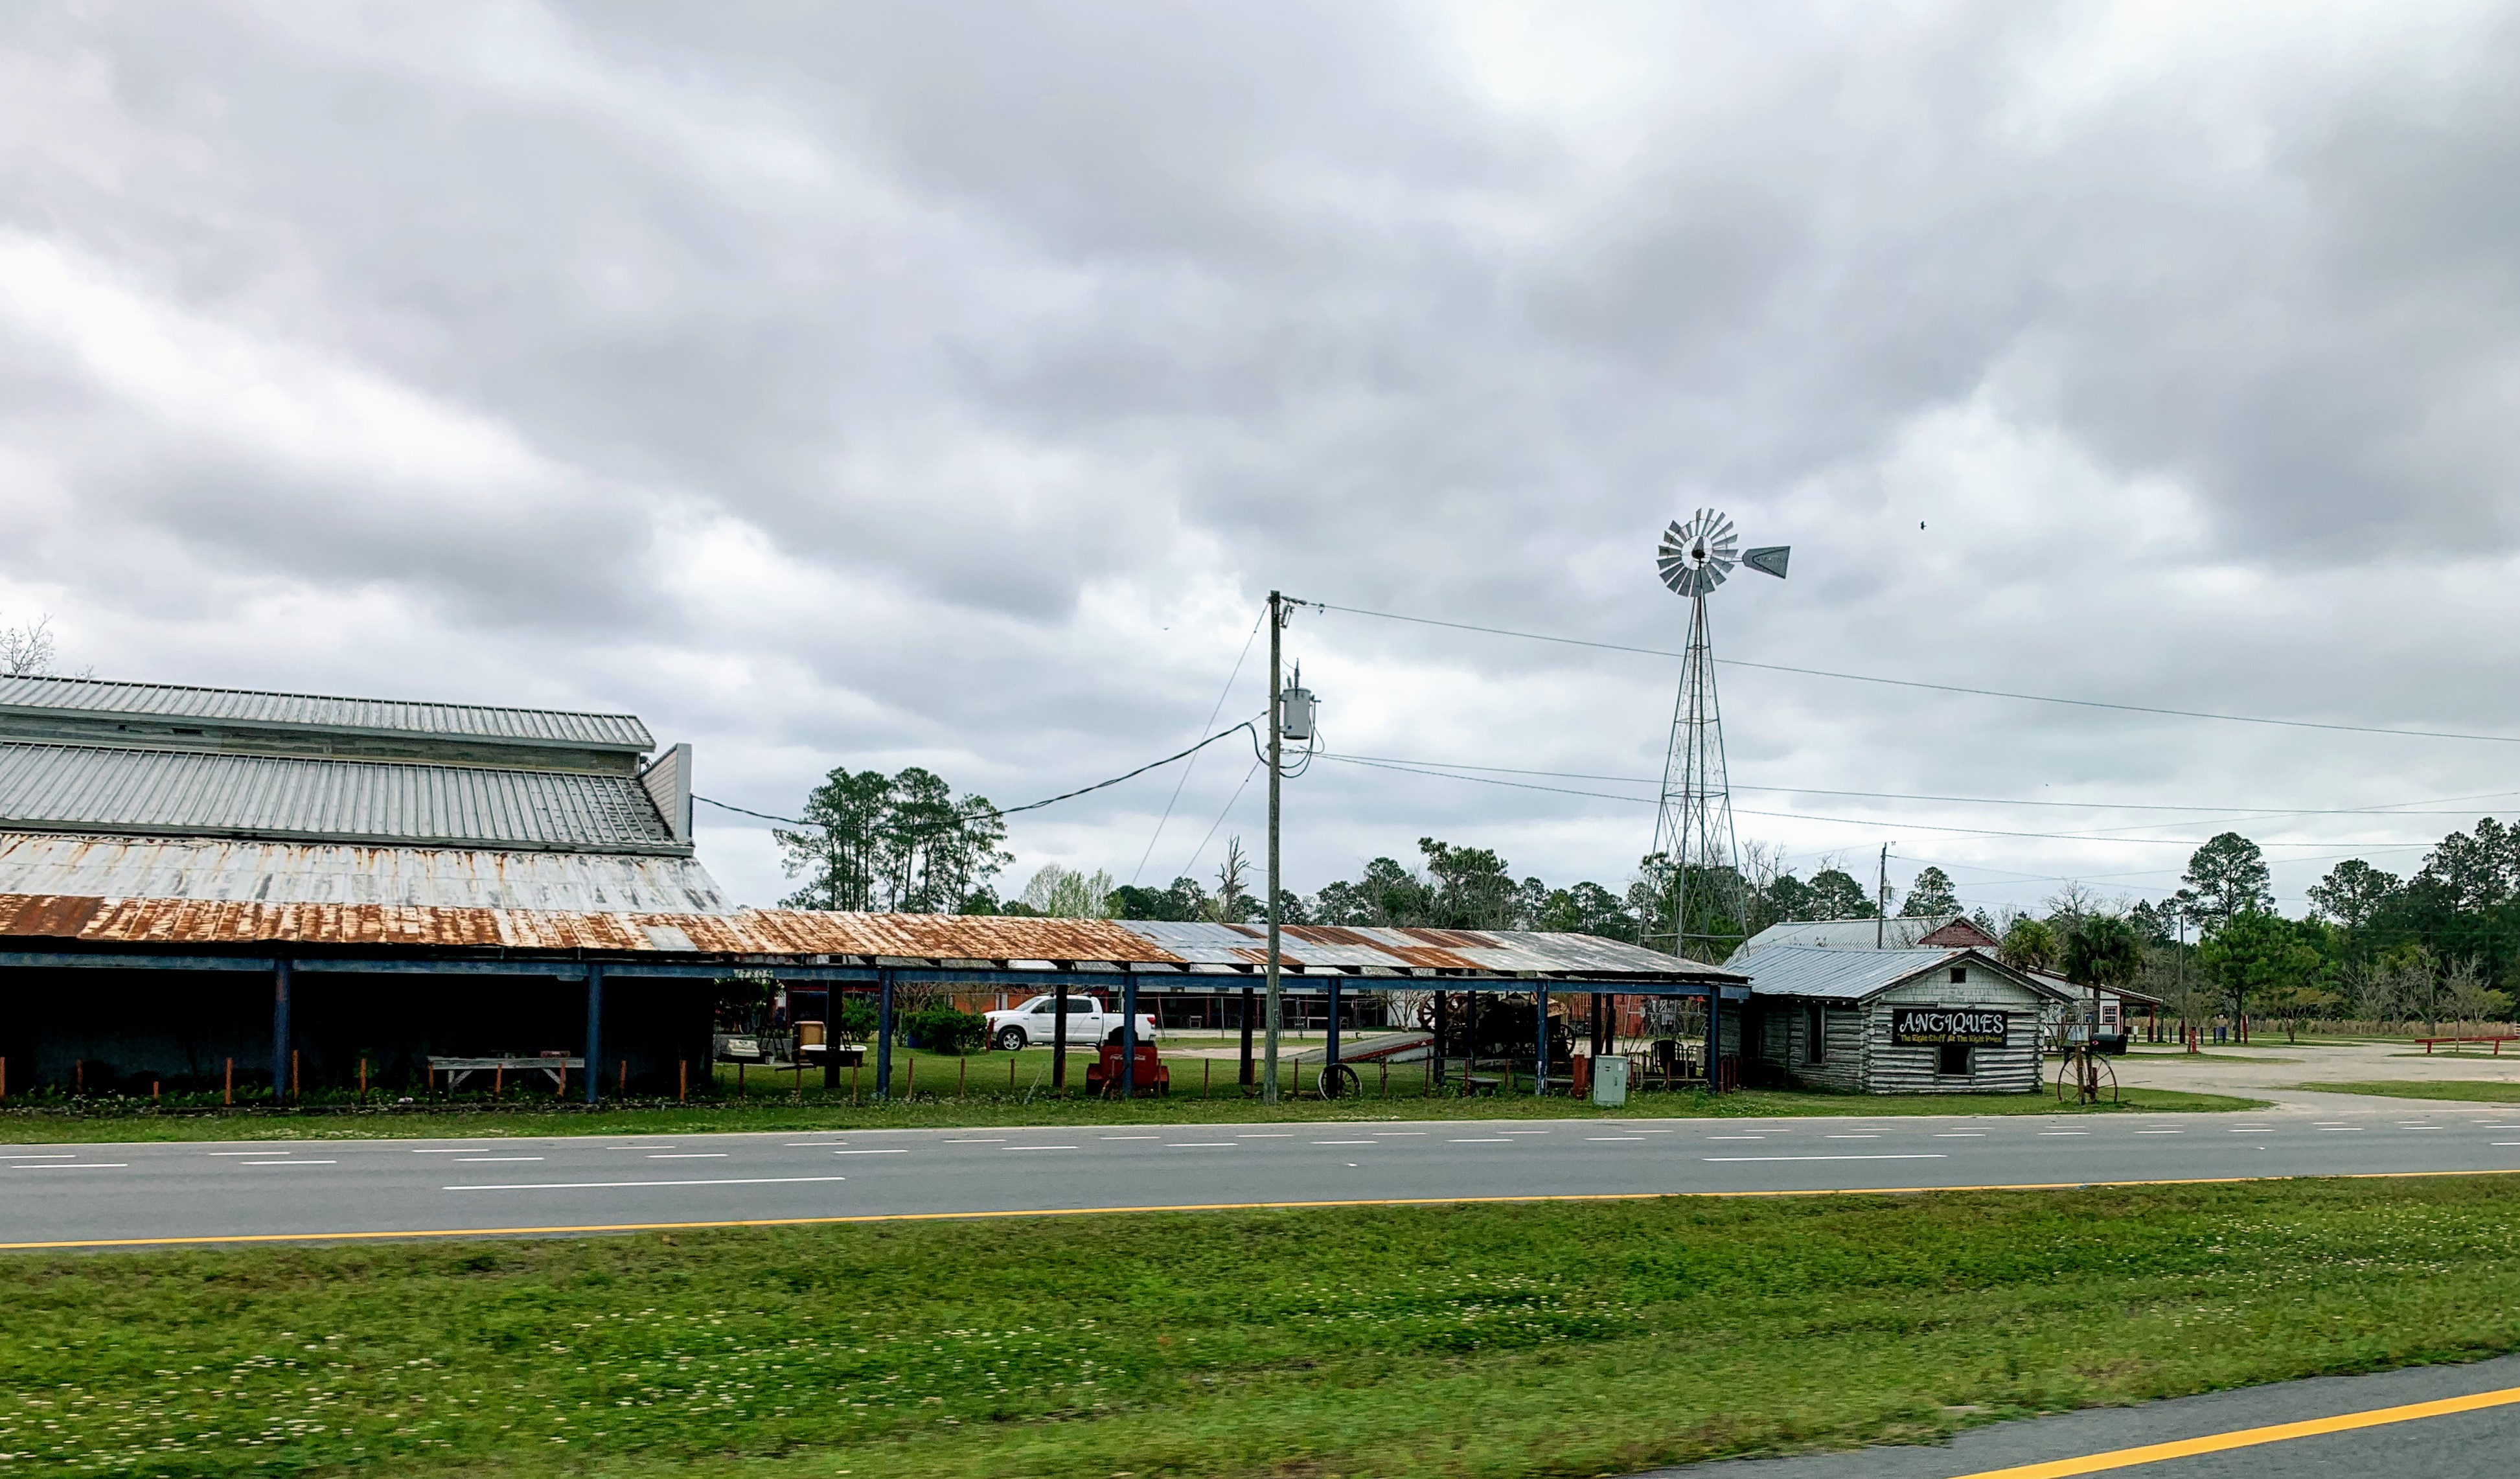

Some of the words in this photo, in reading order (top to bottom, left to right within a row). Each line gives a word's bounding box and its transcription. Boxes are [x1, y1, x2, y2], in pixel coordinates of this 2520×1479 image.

[1899, 1013, 2004, 1035] ANTIQUES
[1912, 1034, 1928, 1043] Right
[1928, 1034, 1946, 1042] Stuff
